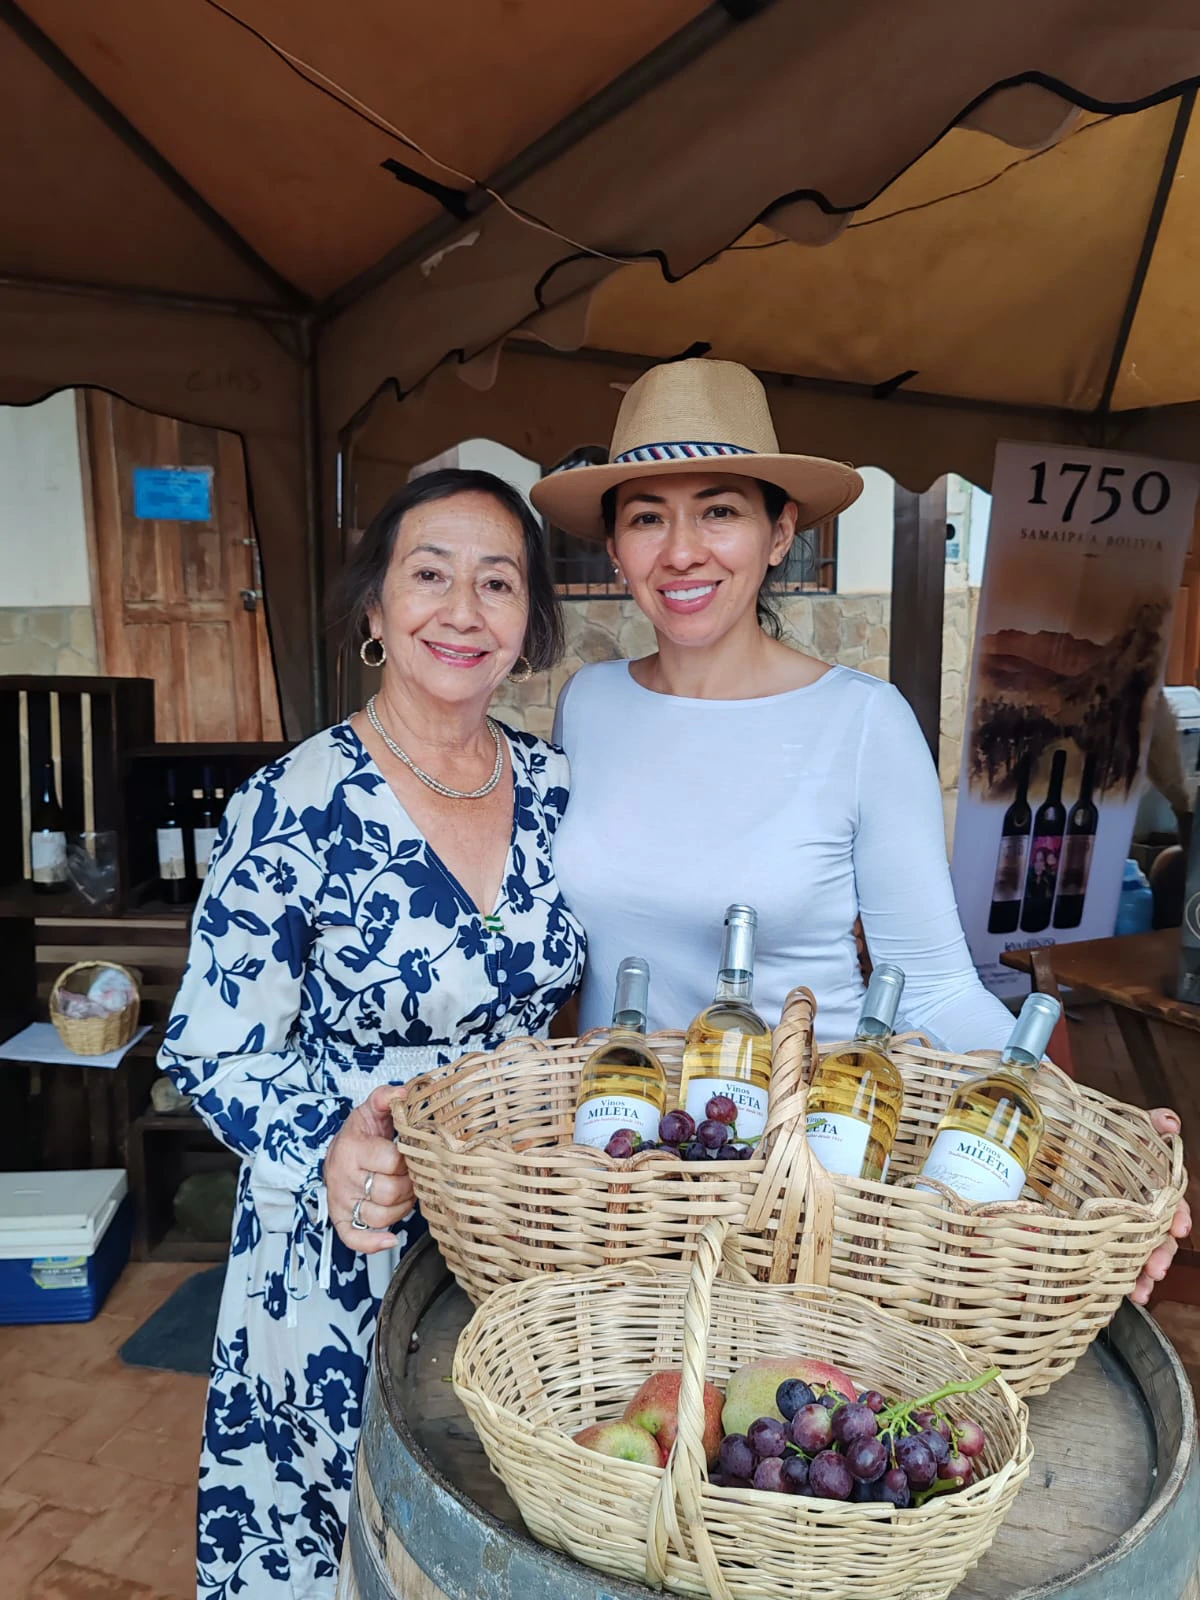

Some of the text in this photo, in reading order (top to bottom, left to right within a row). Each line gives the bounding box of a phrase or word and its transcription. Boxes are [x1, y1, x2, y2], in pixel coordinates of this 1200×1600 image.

[1027, 461, 1171, 525] 1750
[1020, 527, 1099, 546] SAMAIPAA
[726, 1083, 751, 1095] Vinos
[588, 1106, 640, 1119] MILETA
[977, 1140, 1002, 1159] Vinos
[957, 1142, 1009, 1179] MILETA
